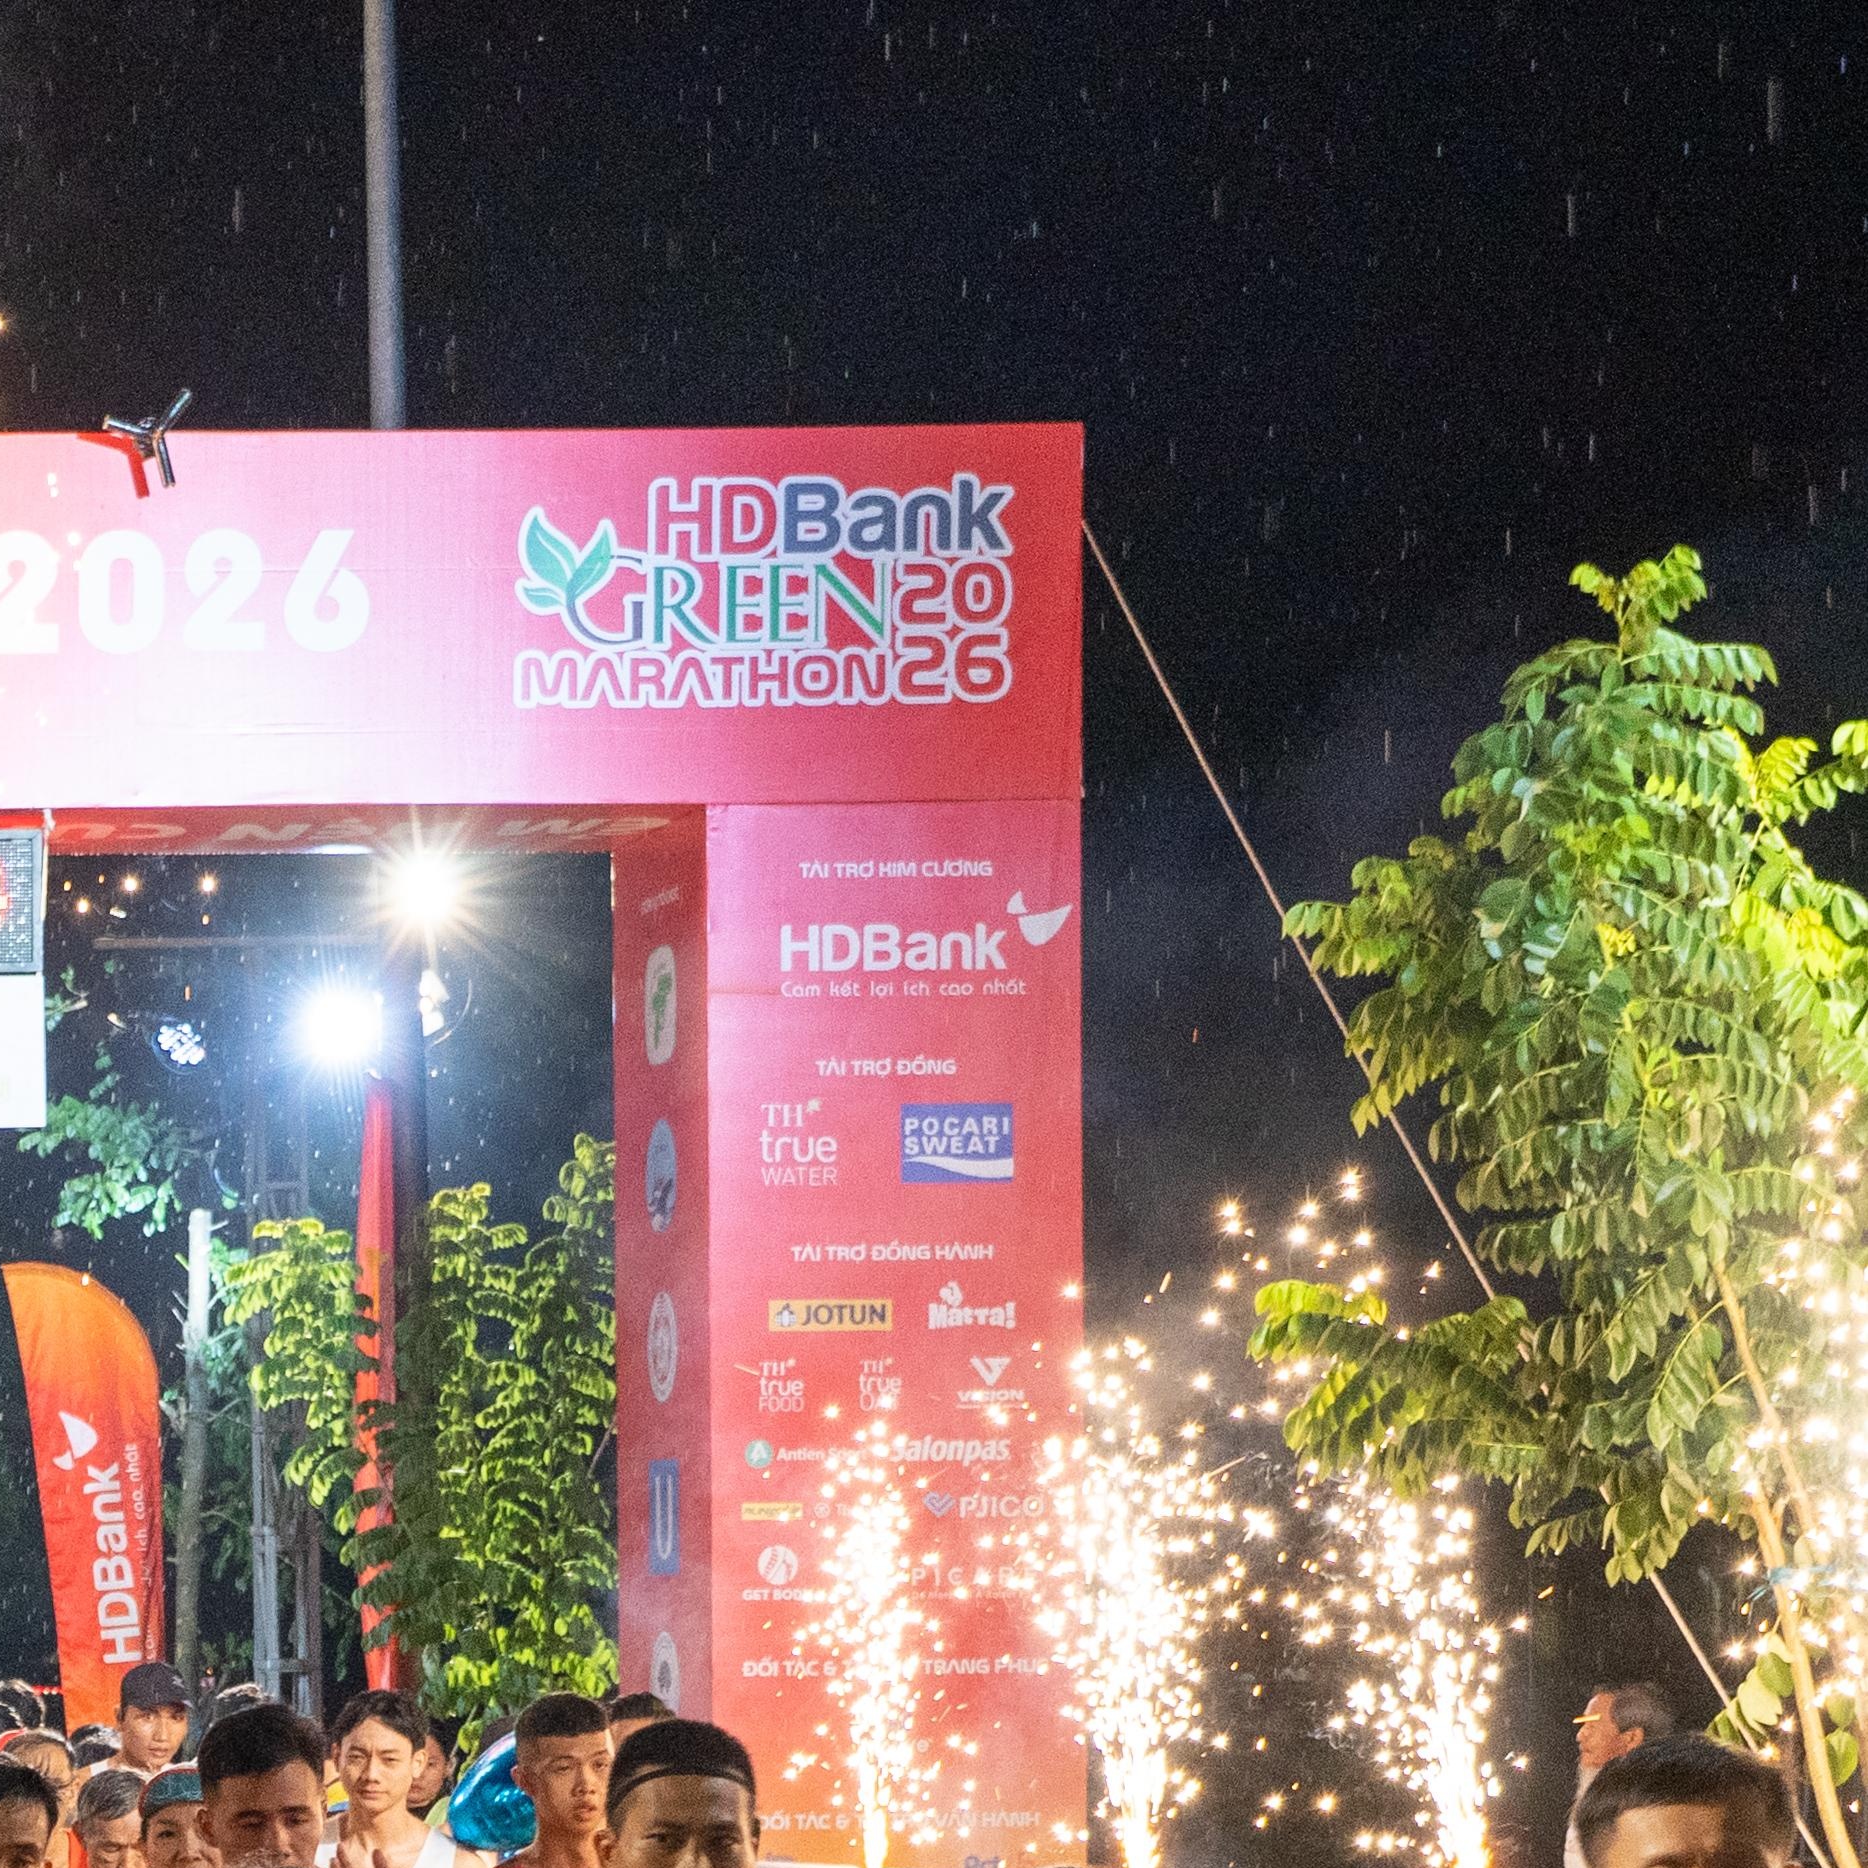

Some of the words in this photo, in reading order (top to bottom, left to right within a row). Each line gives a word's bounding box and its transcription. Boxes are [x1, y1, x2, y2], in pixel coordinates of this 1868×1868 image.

[653, 476, 1012, 558] HDBank
[565, 553, 890, 645] GREEN
[896, 560, 1008, 626] 20
[517, 652, 888, 704] MARATHON
[896, 632, 1010, 700] 26
[779, 922, 1007, 972] HDBank
[761, 1103, 805, 1128] TH
[903, 1115, 1012, 1137] POCARI
[759, 1130, 838, 1162] true
[904, 1136, 1001, 1156] SWEAT
[761, 1166, 839, 1188] WATER
[800, 1303, 888, 1328] JOTUN
[759, 1375, 805, 1397] true
[859, 1374, 902, 1396] true
[776, 1447, 825, 1462] Antien
[959, 1495, 1046, 1519] PJICO
[82, 1461, 143, 1666] HDBank
[743, 1589, 772, 1601] GET
[923, 1657, 990, 1675] TRANG
